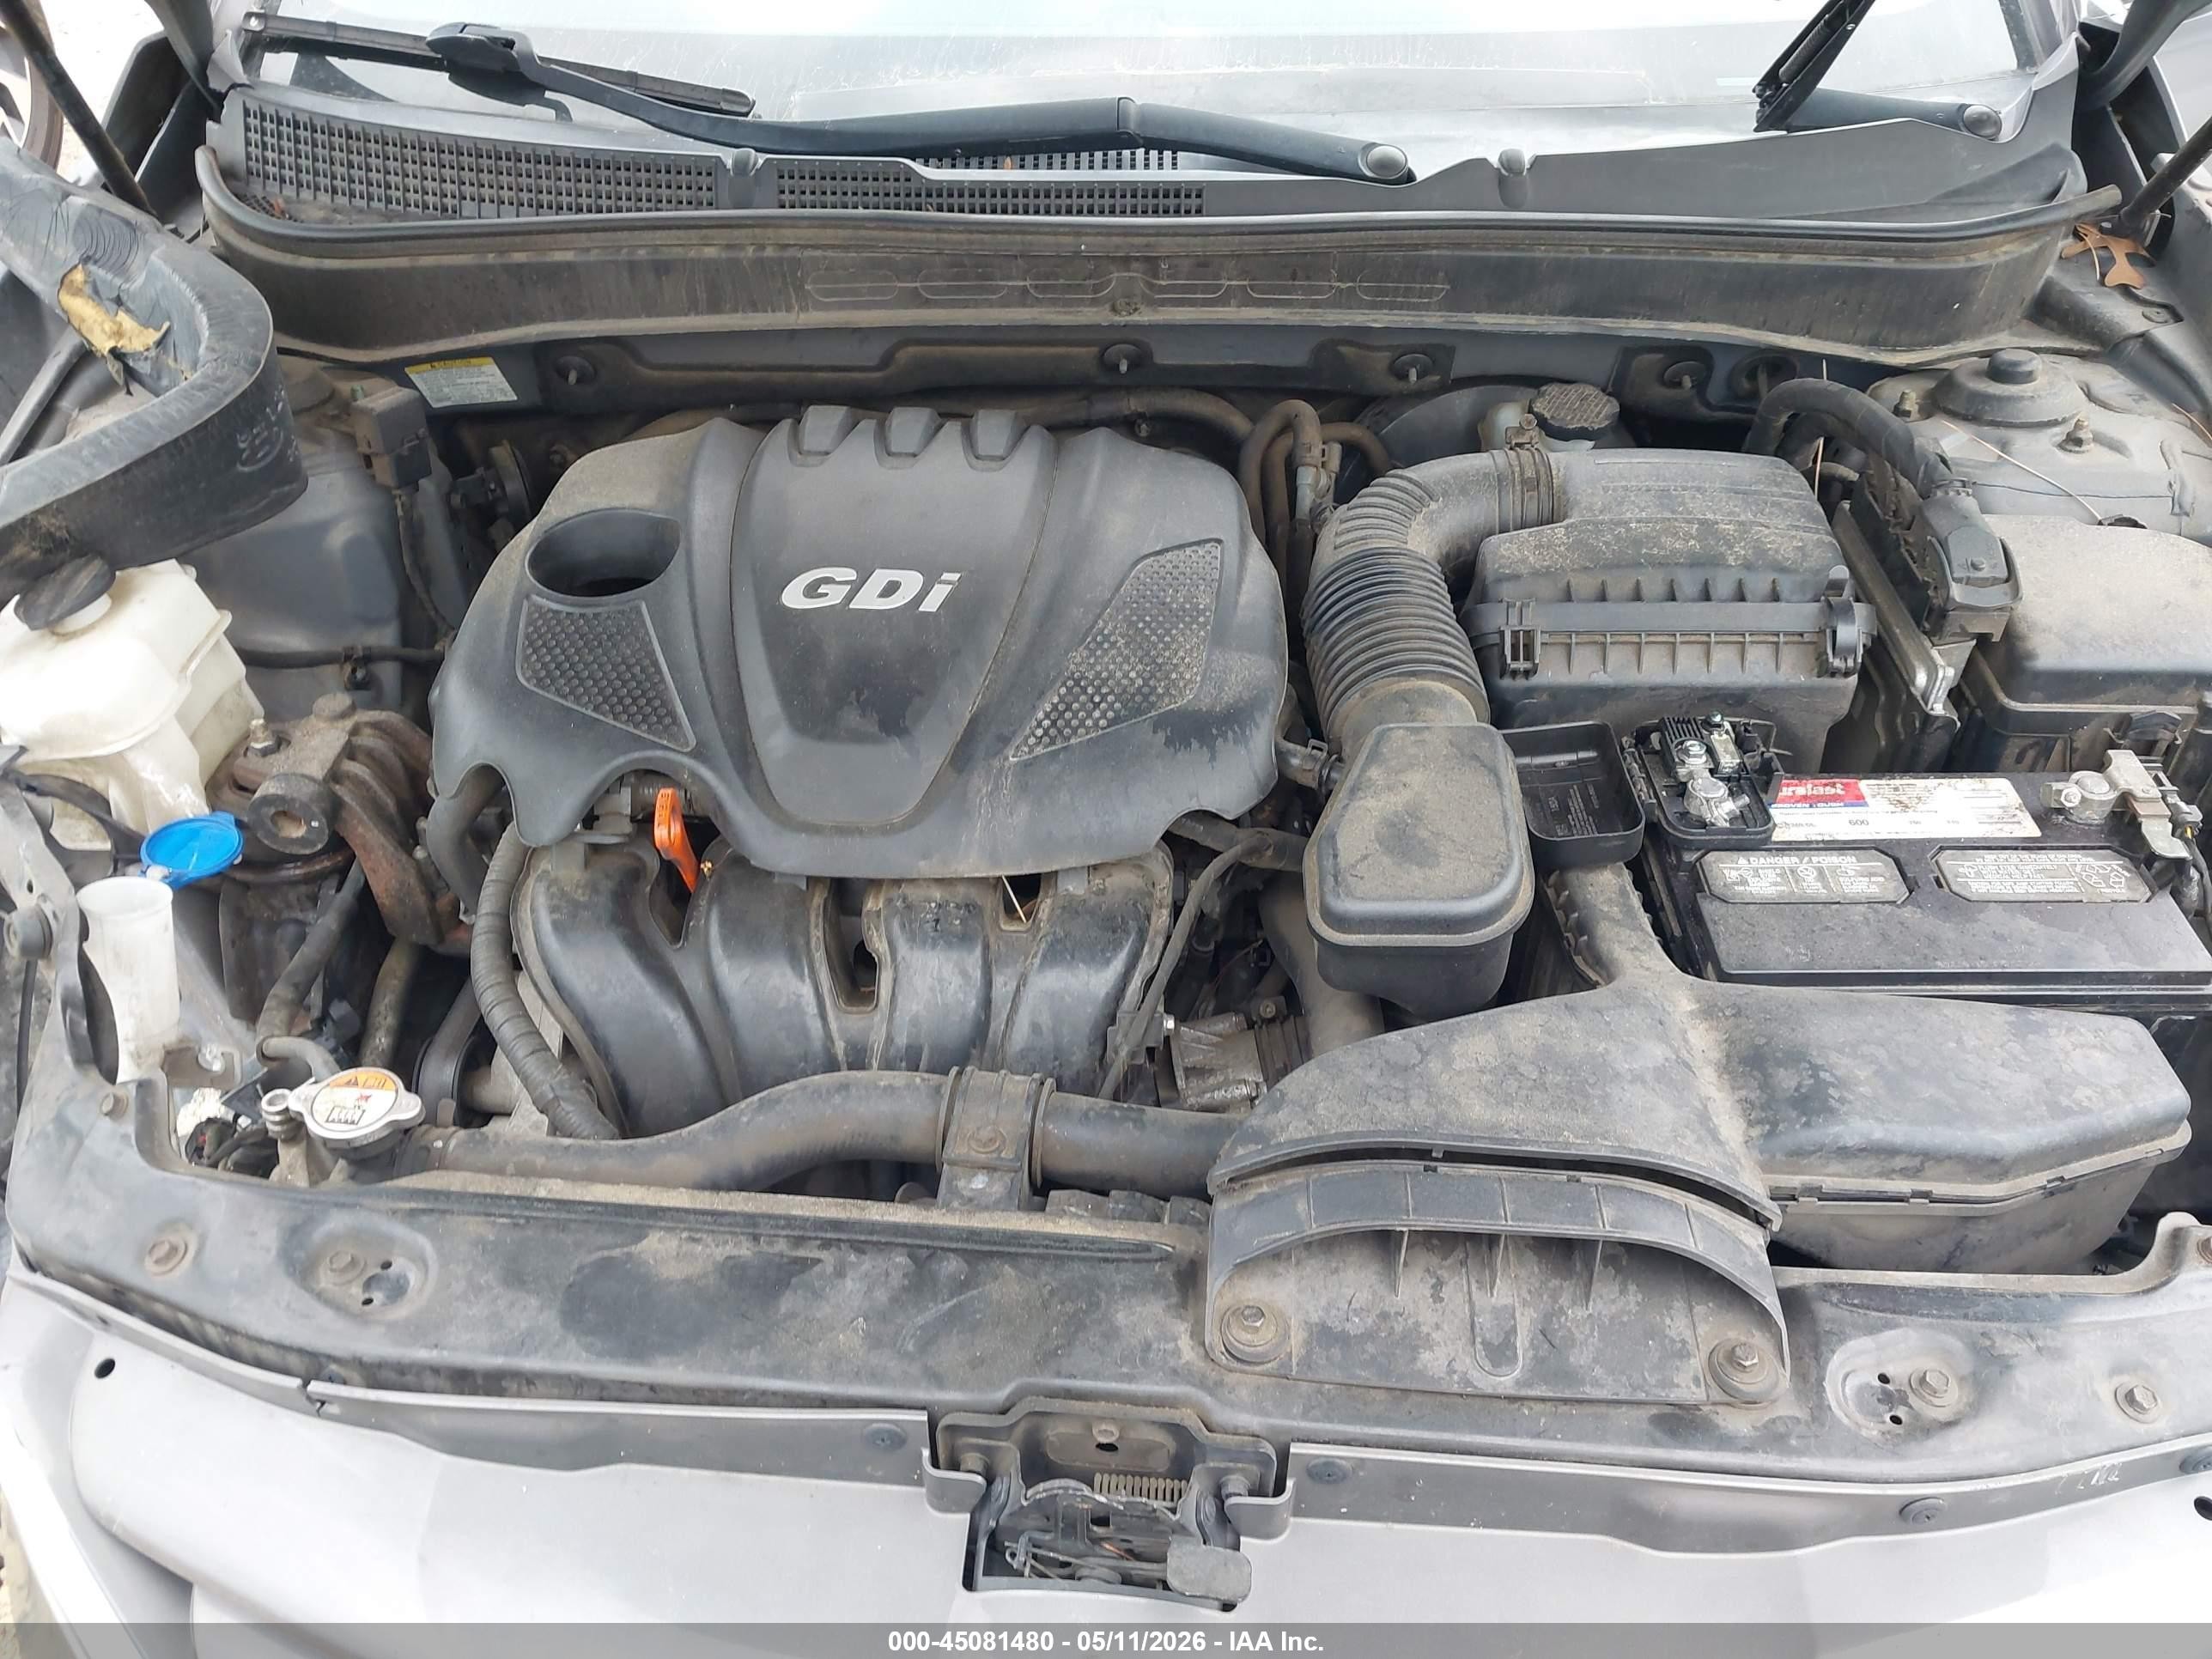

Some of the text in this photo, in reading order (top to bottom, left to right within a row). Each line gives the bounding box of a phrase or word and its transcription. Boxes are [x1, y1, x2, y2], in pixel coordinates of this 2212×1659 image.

[781, 567, 962, 611] GDi
[1749, 856, 1800, 865] DANGER
[1811, 855, 1857, 864] POISON
